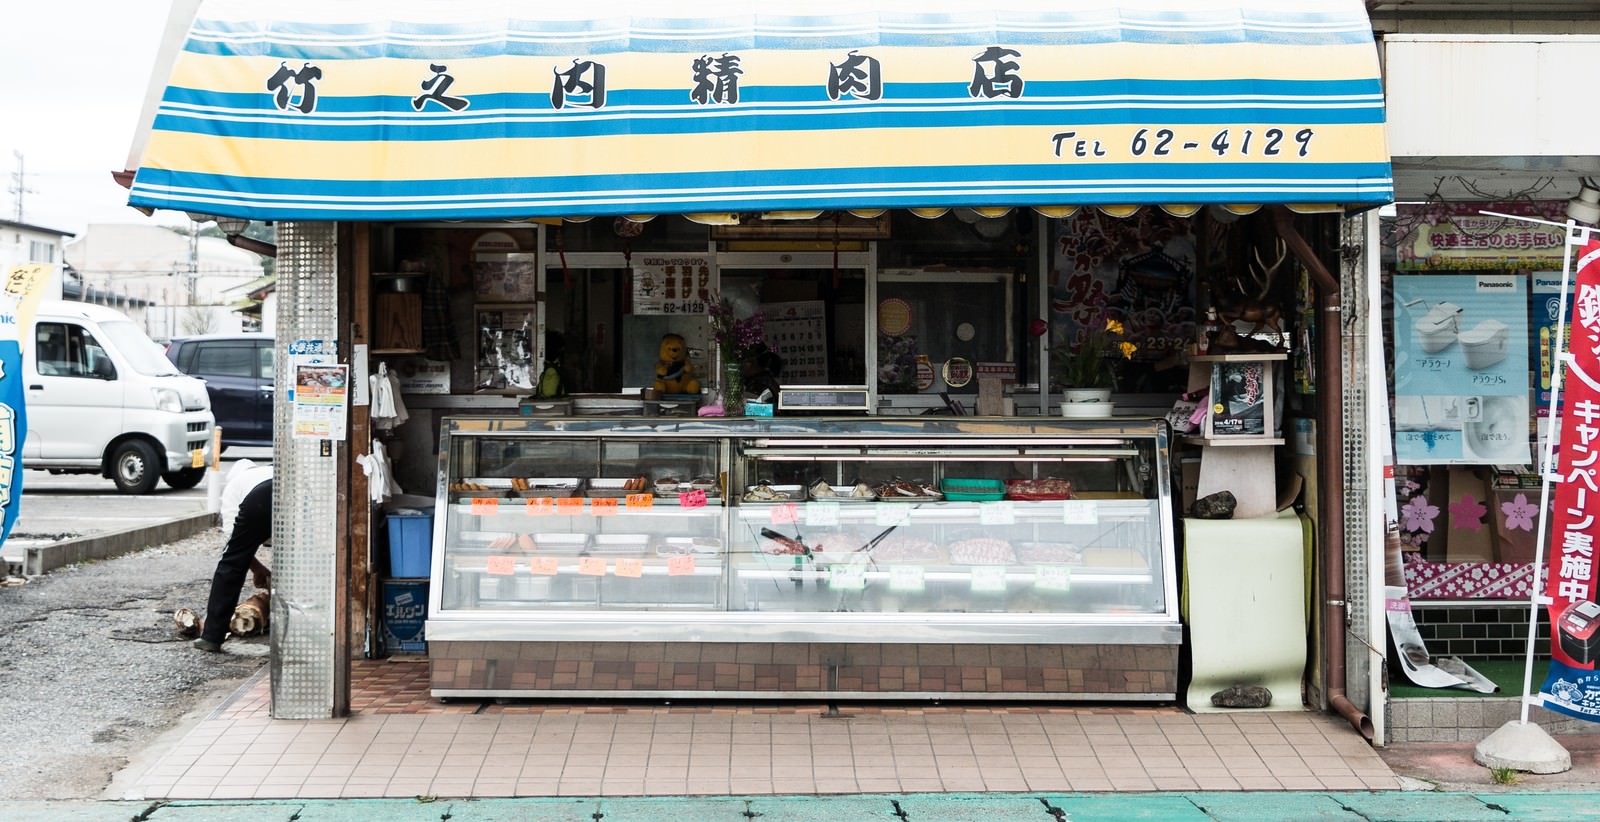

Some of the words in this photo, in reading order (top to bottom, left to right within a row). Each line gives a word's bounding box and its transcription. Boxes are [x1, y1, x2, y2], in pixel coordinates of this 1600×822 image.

[266, 45, 1025, 114] 竹之内精肉店
[1131, 128, 1314, 157] 62-4129
[1430, 232, 1562, 247] 快適生活のお手伝い
[1479, 281, 1514, 289] Panasonic
